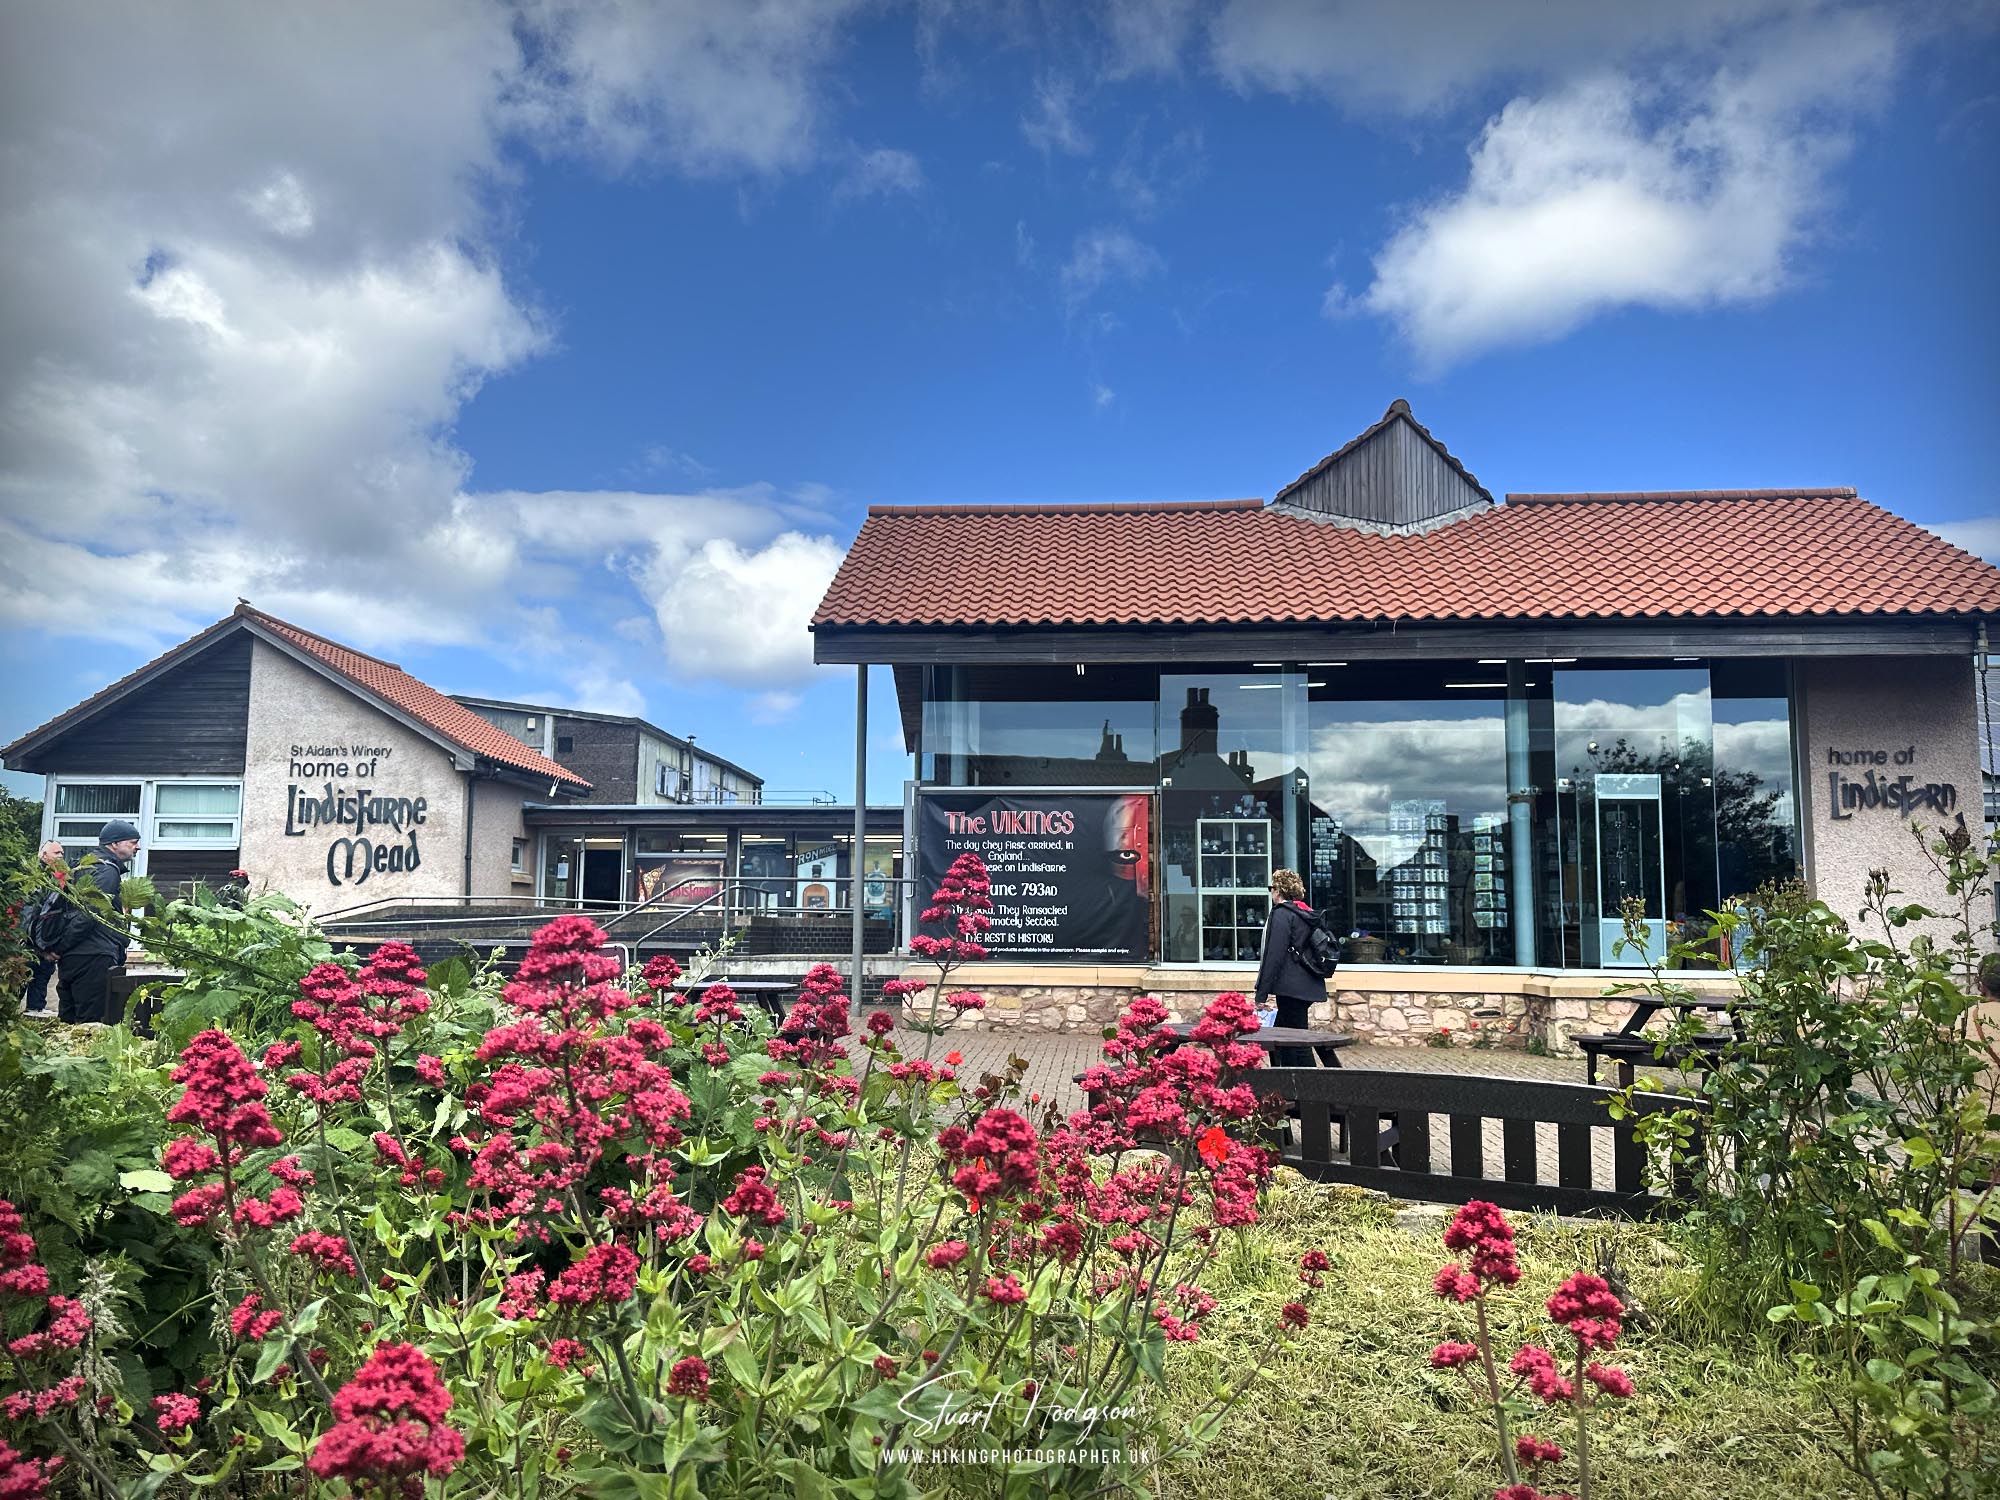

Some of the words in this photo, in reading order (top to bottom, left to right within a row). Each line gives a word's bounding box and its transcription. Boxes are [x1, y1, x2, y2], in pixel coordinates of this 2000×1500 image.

[290, 745, 303, 757] St
[305, 745, 348, 757] Aidan's
[352, 745, 392, 759] Winery
[1828, 746, 1888, 765] home
[1894, 746, 1916, 765] of
[289, 758, 349, 778] home
[356, 758, 378, 778] of
[944, 811, 987, 835] The
[991, 810, 1075, 835] VIKINGS
[945, 839, 962, 850] The
[964, 839, 979, 851] day
[982, 839, 1003, 851] they
[1066, 840, 1074, 850] in
[326, 829, 421, 887] Mead
[1005, 864, 1016, 873] on
[1018, 862, 1067, 873] Lindisfarne
[985, 883, 1017, 898] une
[998, 904, 1020, 917] They
[1022, 905, 1068, 915] Ransacked
[984, 932, 1006, 943] REST
[1008, 932, 1016, 943] IS
[1017, 932, 1054, 944] HISTORY
